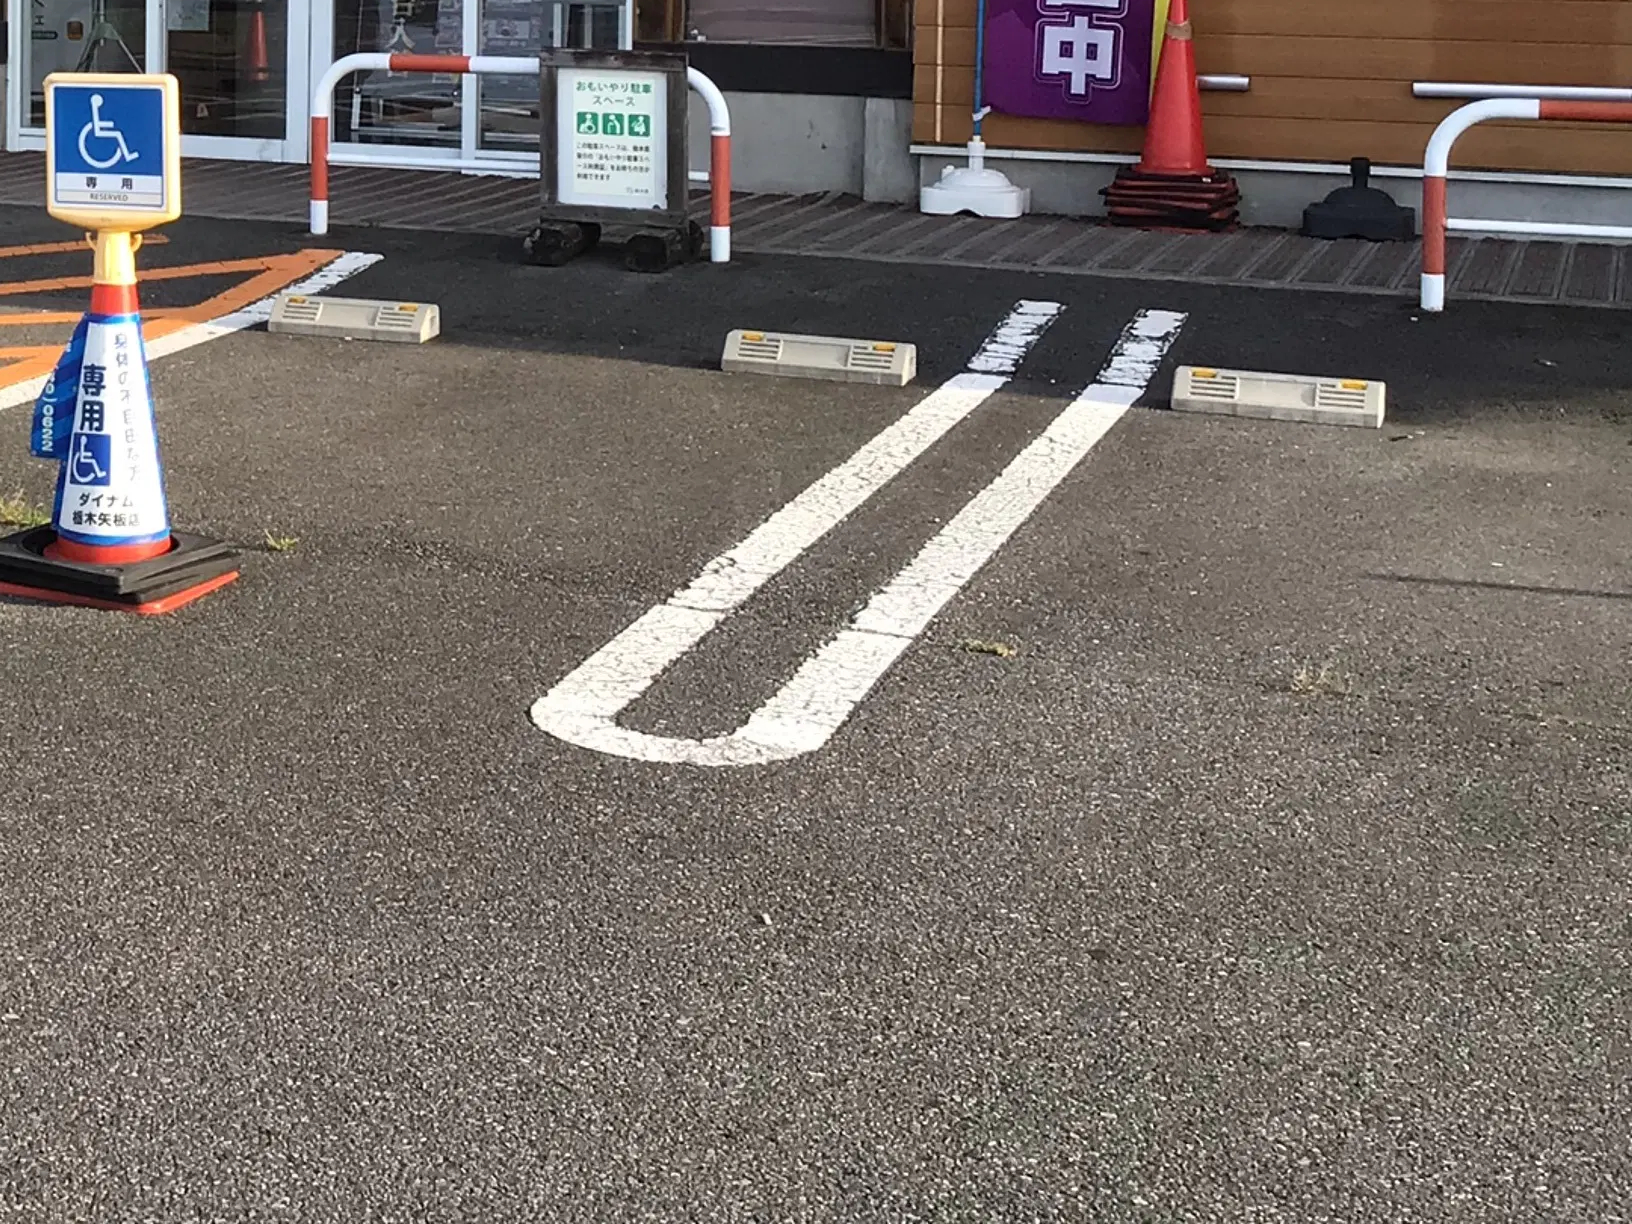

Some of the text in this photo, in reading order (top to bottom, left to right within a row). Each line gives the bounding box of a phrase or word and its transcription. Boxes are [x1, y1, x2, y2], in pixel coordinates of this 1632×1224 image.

[576, 81, 652, 94] おもいやり駐車
[592, 95, 636, 107] スペース
[90, 193, 129, 202] RESERVED
[79, 363, 107, 432] 専用
[79, 493, 134, 508] ダイナム
